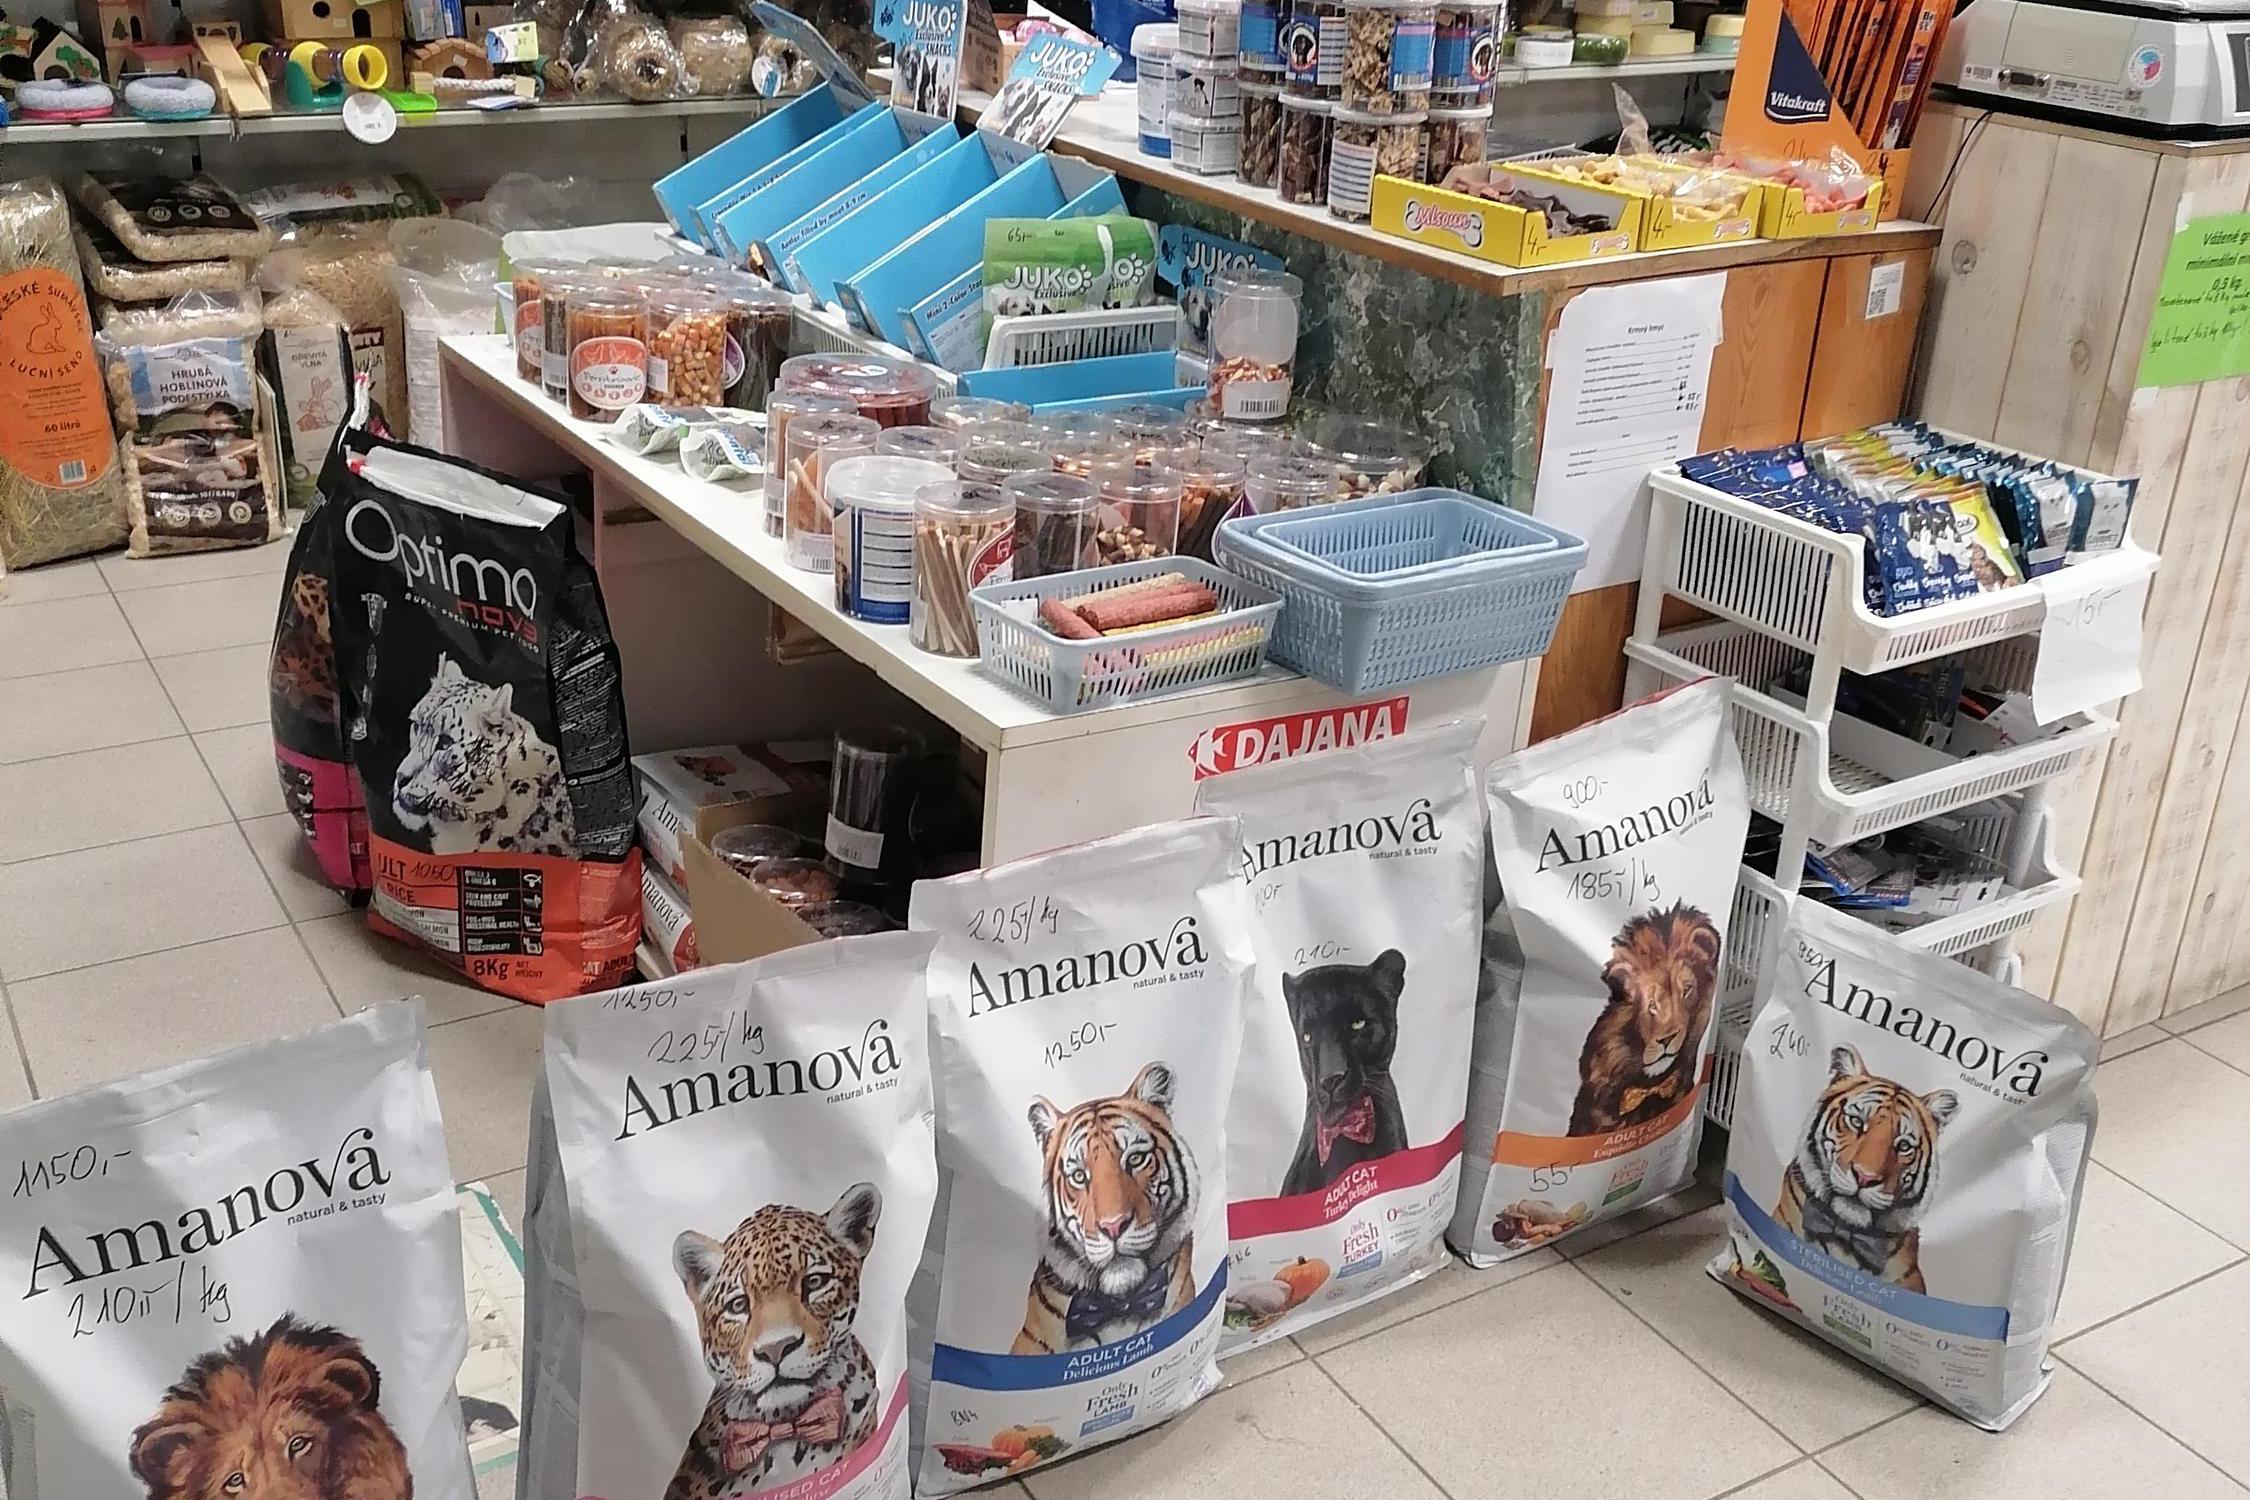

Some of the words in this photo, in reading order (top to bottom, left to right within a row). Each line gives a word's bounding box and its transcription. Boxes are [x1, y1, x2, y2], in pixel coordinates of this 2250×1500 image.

[903, 0, 950, 28] JUKO
[915, 29, 945, 41] Exclusive
[925, 43, 951, 55] SNACKS
[1030, 42, 1087, 74] JUKO
[1042, 81, 1075, 94] SNACKS
[1769, 92, 1828, 114] Vitakraft
[1416, 205, 1470, 230] Mlsoun
[1005, 266, 1084, 291] JUKO
[57, 350, 83, 377] SENO
[171, 364, 213, 379] HRUBÁ
[159, 376, 228, 393] HOBLINOVÁ
[457, 597, 538, 643] nova
[1235, 707, 1392, 768] DAJANA
[1369, 850, 1402, 860] natural
[1405, 848, 1412, 856] &
[1413, 846, 1438, 856] tasty
[1133, 975, 1167, 989] natural
[1169, 973, 1177, 982] &
[1179, 968, 1205, 981] tasty
[826, 1088, 864, 1105] natural
[866, 1085, 874, 1094] &
[875, 1077, 898, 1092] tasty
[1959, 1072, 1992, 1094] natural
[1324, 1176, 1351, 1206] ADULT
[1351, 1166, 1378, 1184] CAT
[1347, 1179, 1379, 1202] Delight
[287, 1203, 335, 1227] natural
[338, 1200, 348, 1212] &
[352, 1191, 386, 1209] tasty
[1342, 1223, 1380, 1256] Fresh
[1344, 1240, 1379, 1264] TURKEY
[1867, 1278, 1899, 1299] CAT
[1067, 1346, 1120, 1369] ADULT
[1125, 1331, 1155, 1353] CAT
[1062, 1359, 1121, 1382] Delicious
[1122, 1344, 1154, 1365] Lamb
[1085, 1382, 1139, 1413] Fresh
[1093, 1400, 1128, 1418] LAMB
[818, 1460, 851, 1487] CAT
